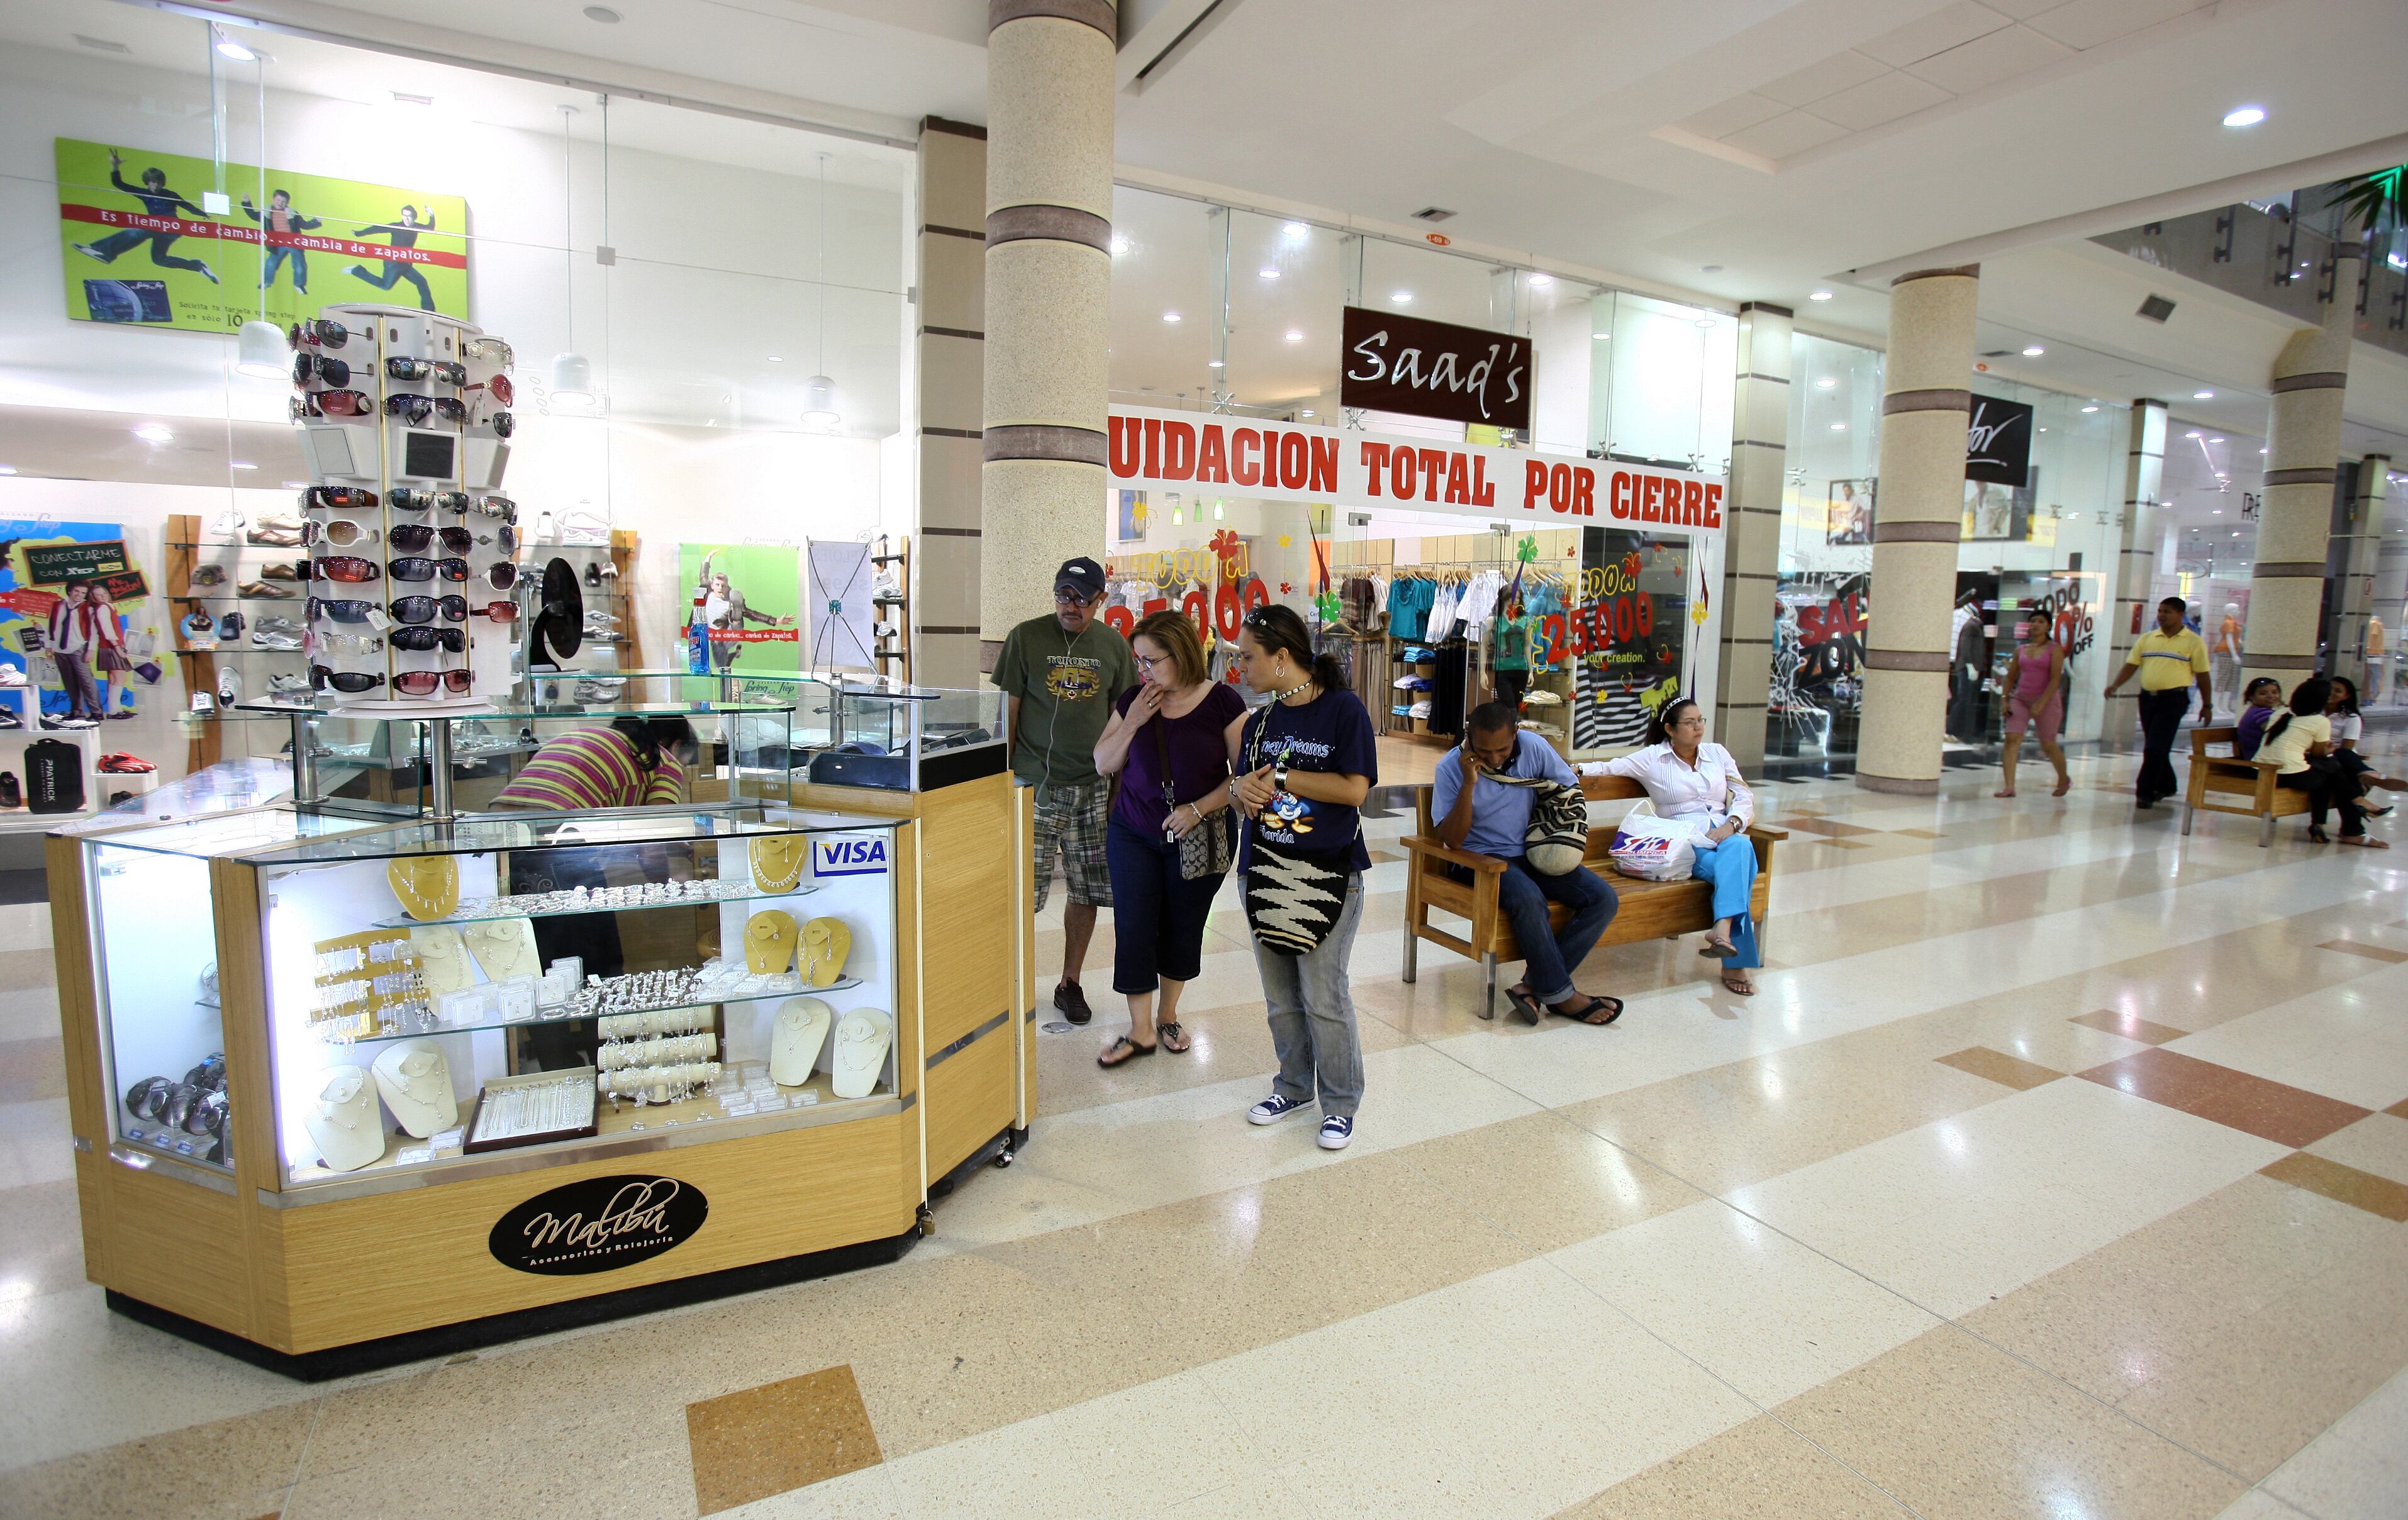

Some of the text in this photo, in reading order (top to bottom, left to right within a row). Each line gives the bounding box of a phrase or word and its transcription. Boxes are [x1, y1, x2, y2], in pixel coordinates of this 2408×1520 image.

[100, 211, 116, 222] Es
[190, 222, 207, 234] de
[351, 243, 366, 253] de
[228, 314, 243, 327] 10
[1347, 330, 1524, 419] Saad's
[1361, 441, 1495, 507] TOTAL
[1523, 459, 1595, 517] POR
[1610, 471, 1723, 528] CIERRE
[31, 549, 121, 564] CONECTARME
[1132, 540, 1249, 591] TODO A
[40, 569, 63, 577] CON
[1564, 564, 1619, 604] TODO
[1798, 590, 1870, 647] SAL
[2074, 634, 2093, 655] OFF
[1046, 656, 1101, 668] TORONTO
[1585, 652, 1646, 666] your creation.
[1279, 735, 1329, 757] Dreams
[46, 766, 56, 802] PATRICK
[820, 841, 886, 864] VISA
[606, 1246, 611, 1254] y
